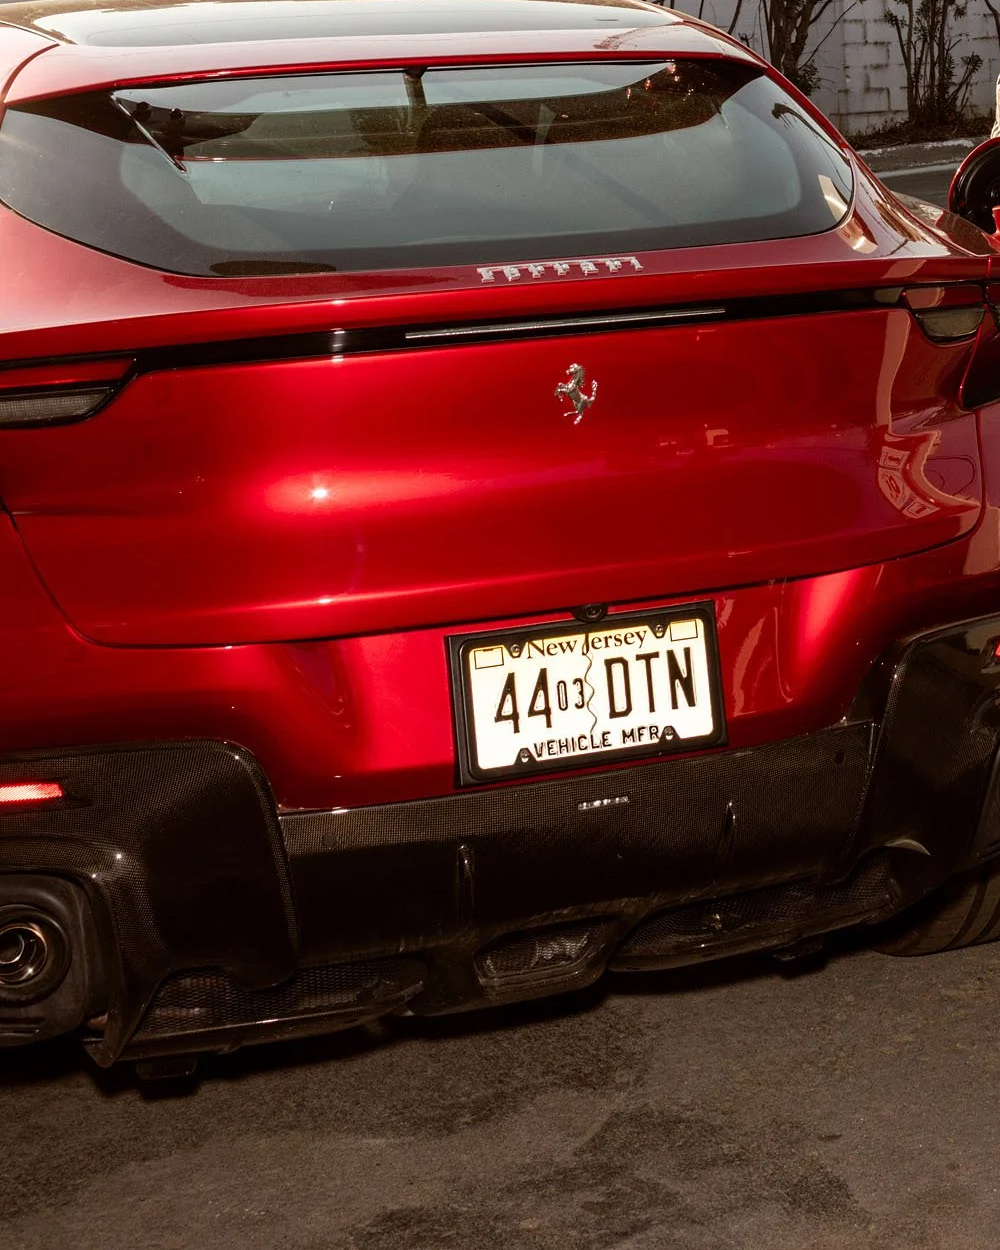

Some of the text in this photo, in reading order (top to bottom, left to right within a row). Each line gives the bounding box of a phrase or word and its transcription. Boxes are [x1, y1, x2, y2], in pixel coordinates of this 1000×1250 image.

[526, 628, 647, 660] New Jersey
[604, 647, 697, 719] DTN
[533, 725, 661, 758] VEHICLE MFR
